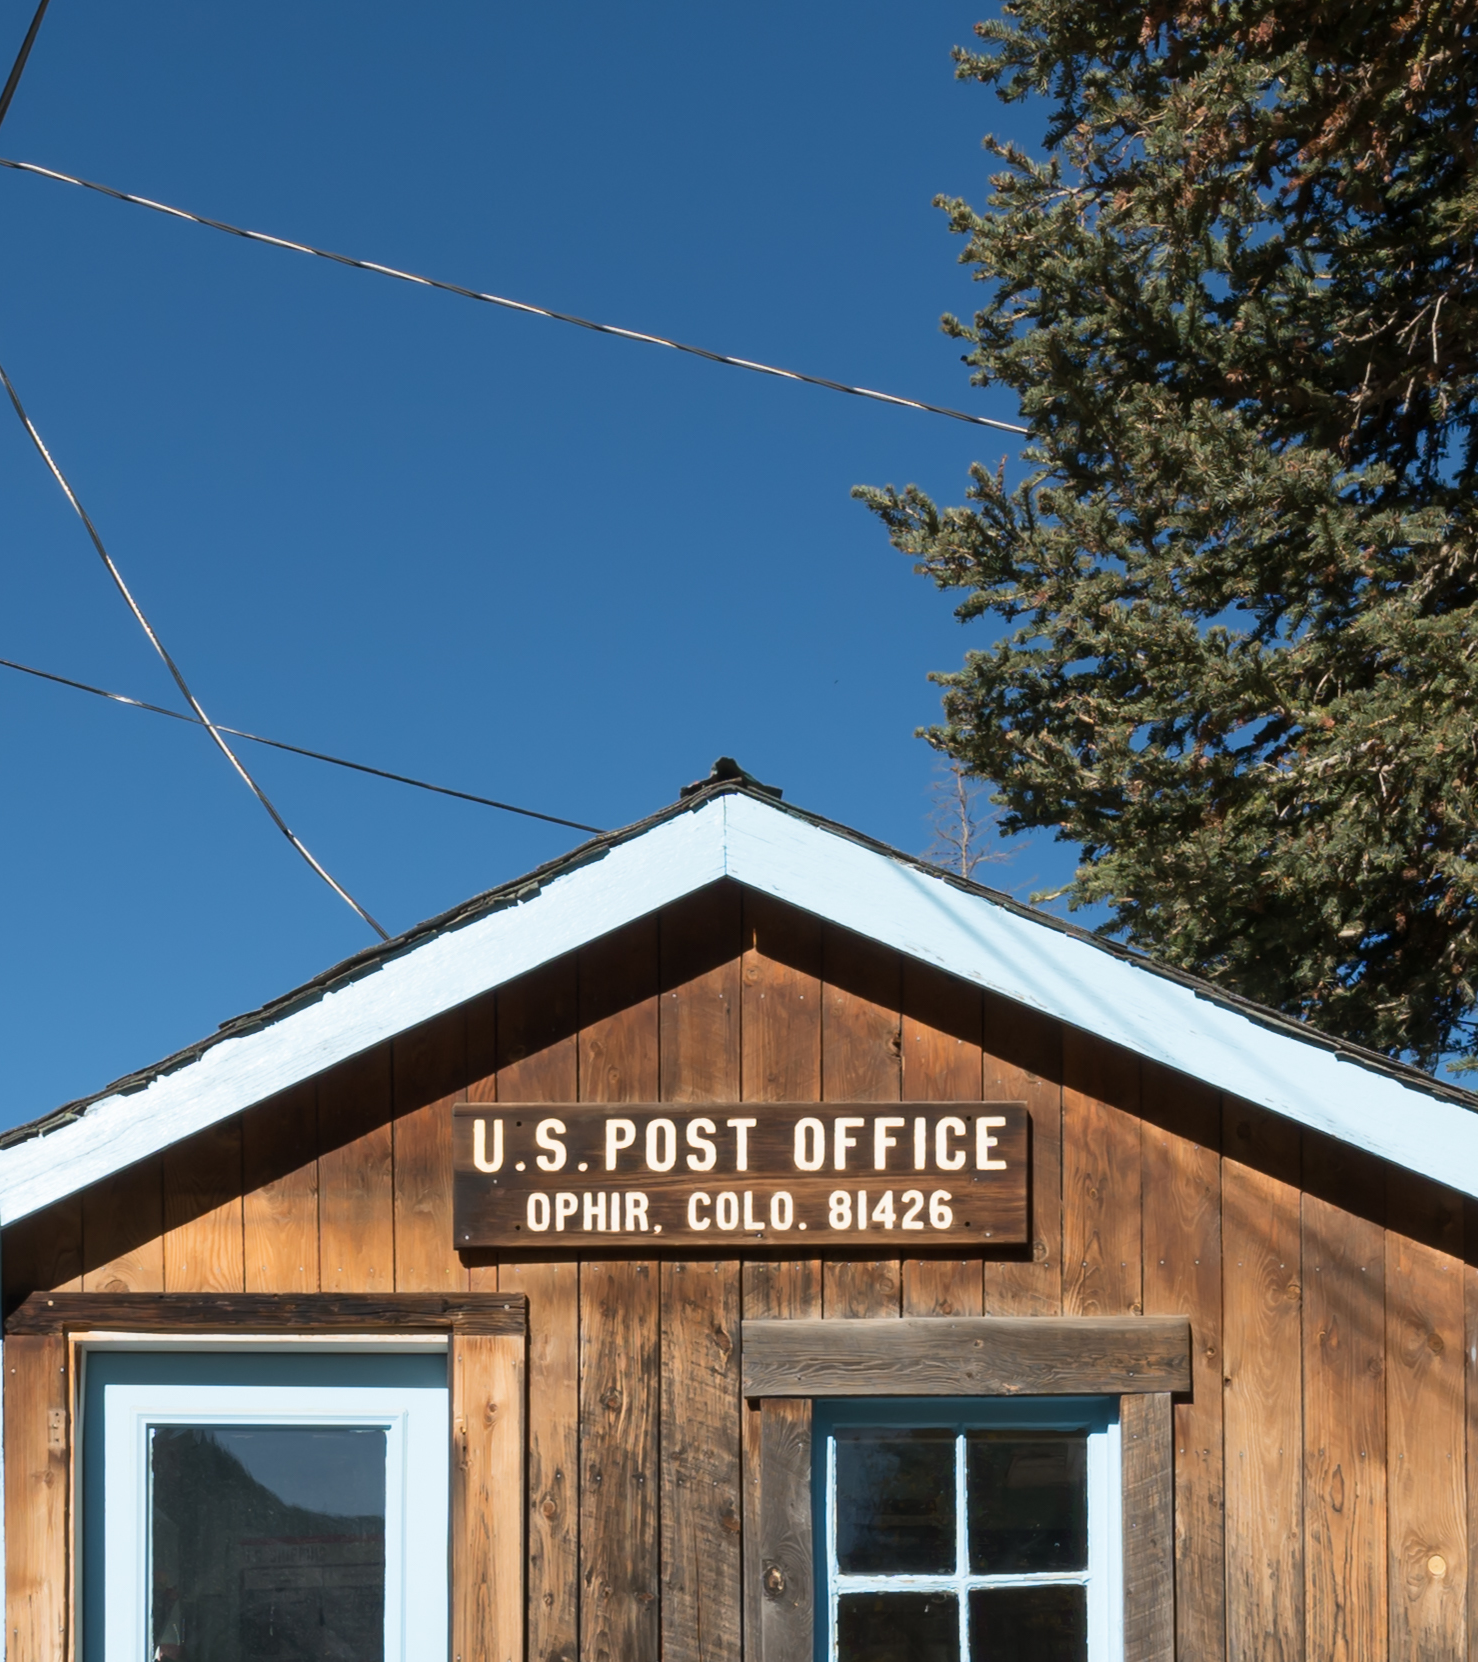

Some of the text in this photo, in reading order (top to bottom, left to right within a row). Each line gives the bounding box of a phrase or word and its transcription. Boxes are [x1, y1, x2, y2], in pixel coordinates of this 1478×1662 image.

[605, 1116, 757, 1172] POST
[793, 1115, 1008, 1172] OFFICE
[526, 1188, 954, 1235] OPHIR, COLO. 81426
